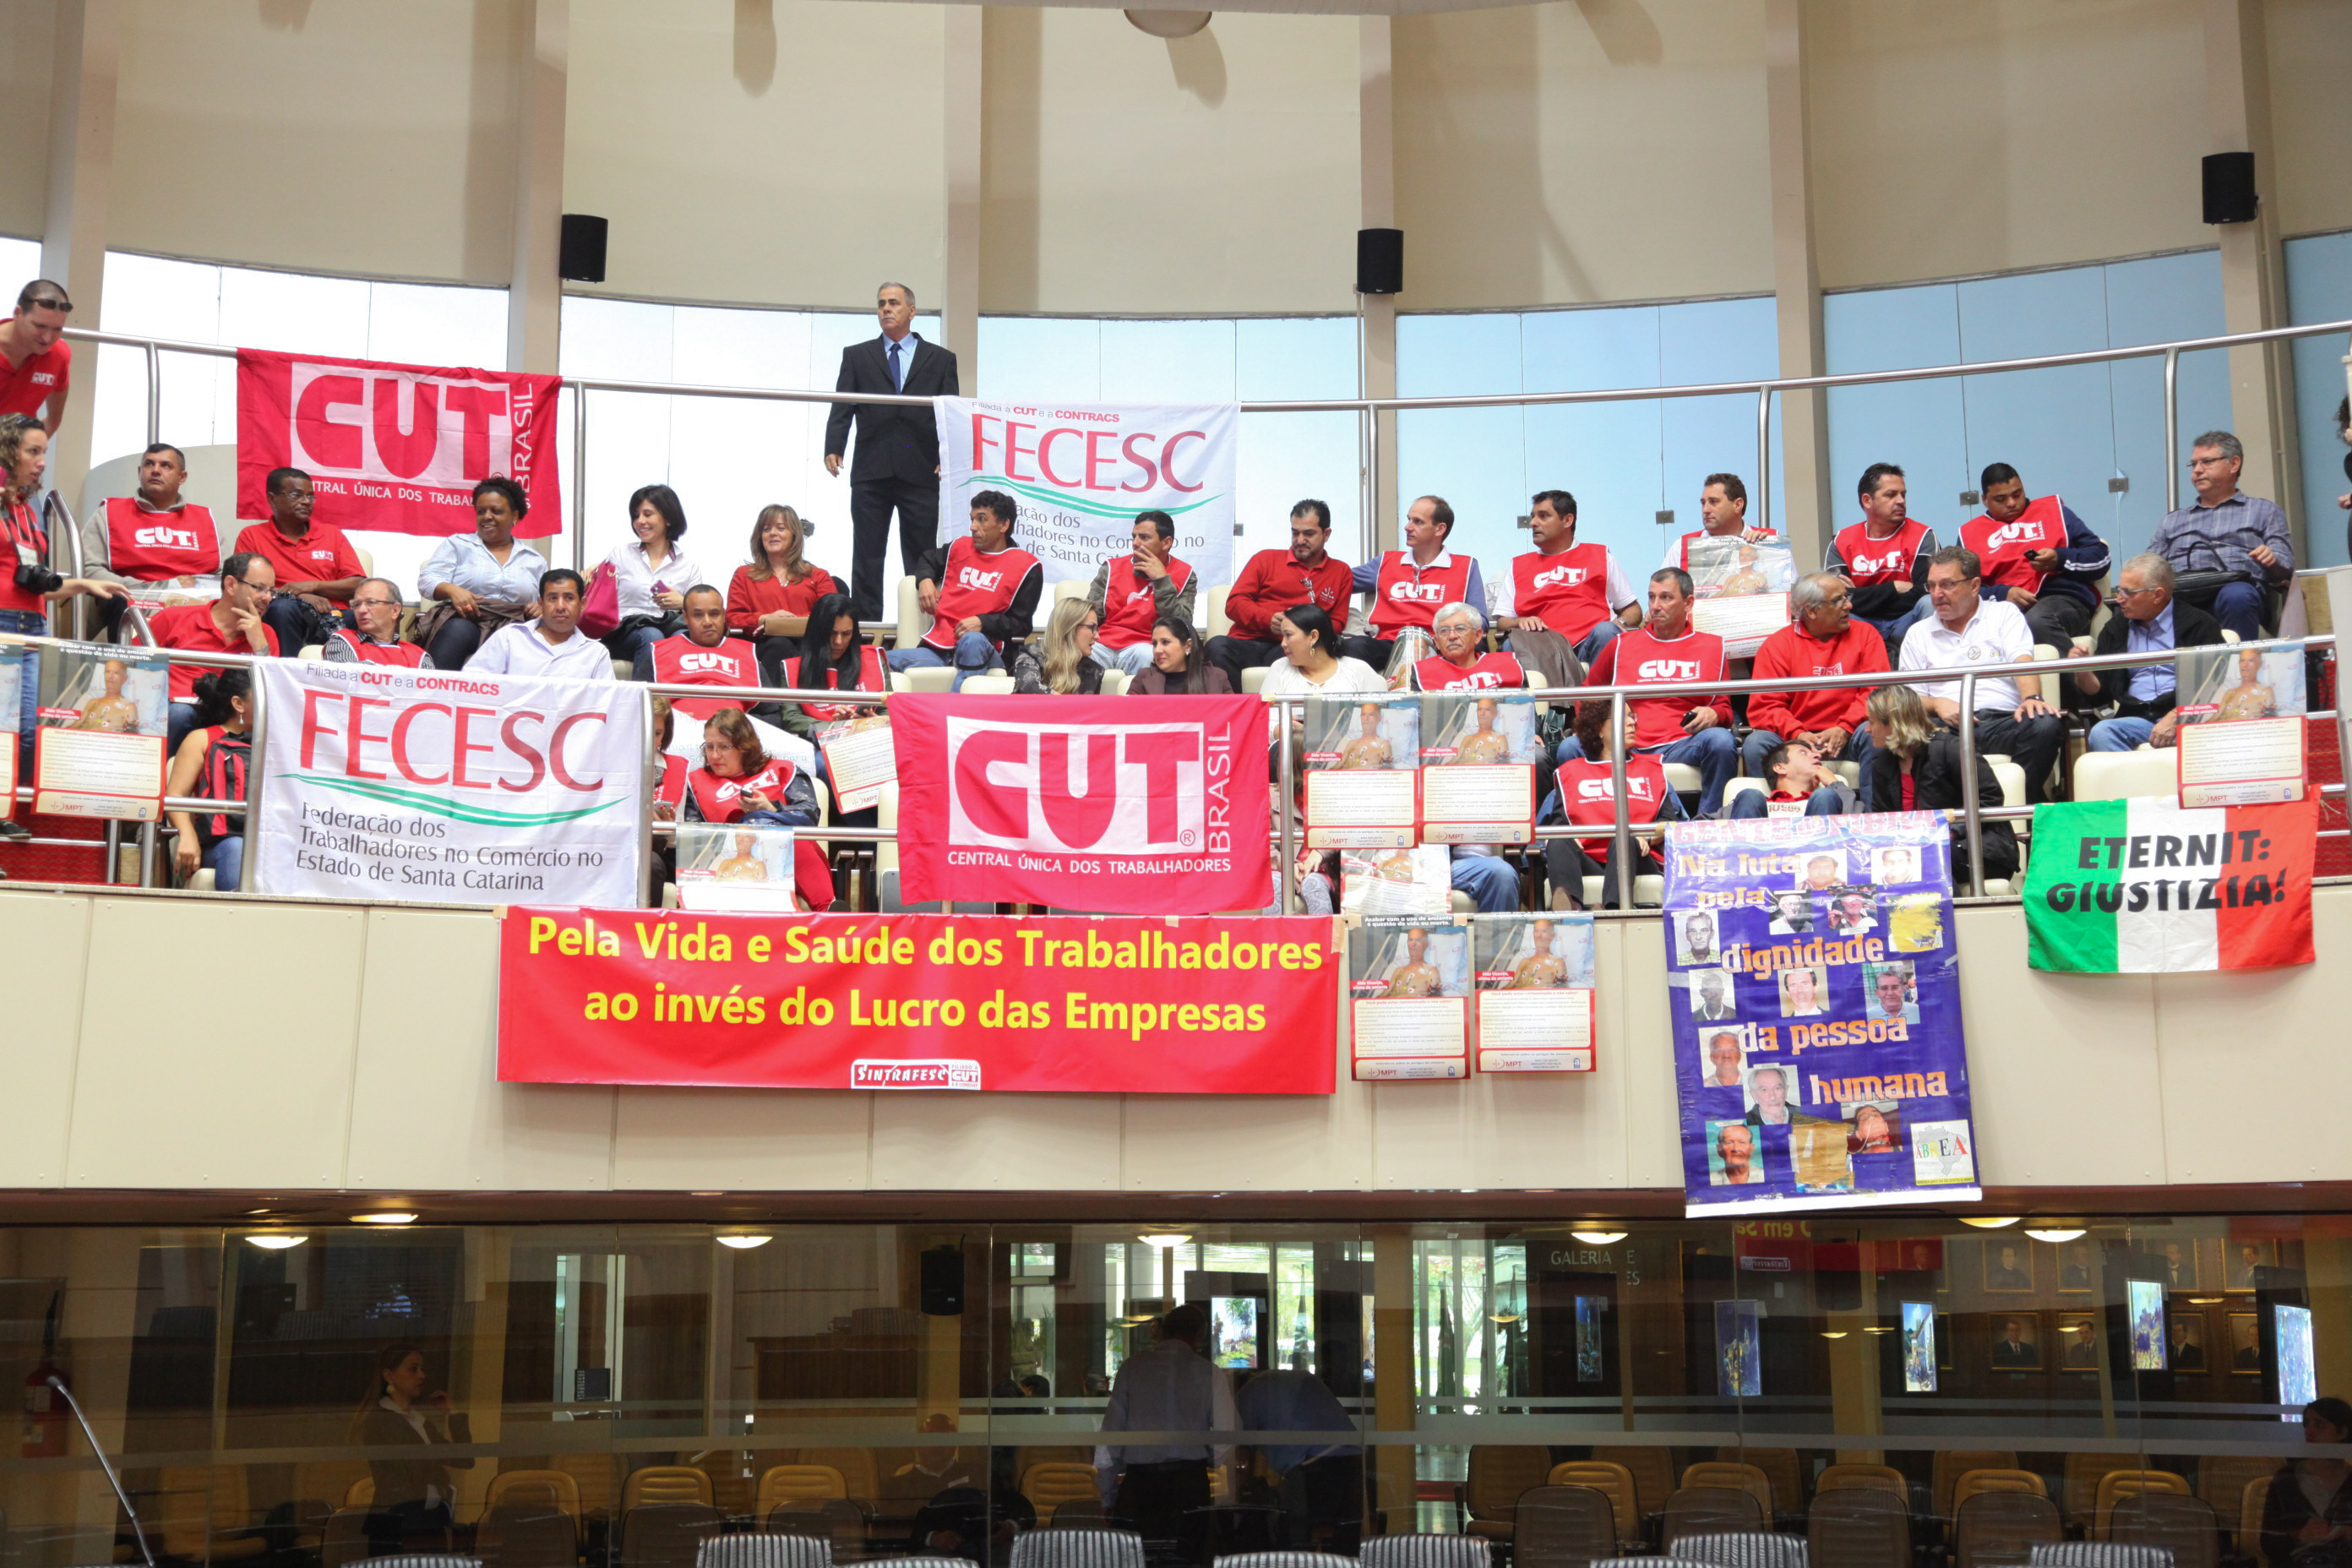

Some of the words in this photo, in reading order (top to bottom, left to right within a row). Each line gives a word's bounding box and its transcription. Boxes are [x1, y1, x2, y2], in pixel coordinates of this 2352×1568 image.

[972, 401, 1002, 412] Filiada
[1013, 406, 1037, 416] CUT
[1055, 410, 1120, 422] CONTRACS
[296, 374, 507, 480] CUT
[514, 383, 533, 493] BRASIL
[972, 413, 1206, 493] FECESC
[354, 481, 392, 498] ÚNICA
[399, 488, 423, 502] DOS
[1053, 511, 1081, 529] dos
[135, 526, 191, 546] CUT
[1081, 536, 1100, 548] no
[1185, 535, 1205, 547] no
[1987, 522, 2037, 548] CUT
[1026, 540, 1045, 555] de
[1050, 544, 1091, 565] Santa
[1853, 551, 1901, 573] CUT
[960, 566, 999, 587] CUT
[1533, 565, 1582, 588] CUT
[1391, 581, 1441, 599] CUT
[679, 653, 734, 673] CUT
[1638, 660, 1696, 678] CUT
[307, 663, 347, 682] Filiada
[350, 672, 359, 682] a
[361, 672, 393, 686] CUT
[394, 678, 403, 688] e
[406, 678, 414, 689] a
[416, 677, 500, 696] CONTRACS
[300, 689, 607, 792] FECESC
[863, 794, 878, 804] MPT
[955, 729, 1200, 849] CUT
[1208, 722, 1231, 852] BRASIL
[302, 802, 402, 839] Federação
[410, 817, 446, 838] dos
[299, 825, 438, 863] Trabalhadores
[444, 847, 469, 864] no
[476, 846, 571, 868] Comércio
[578, 850, 603, 868] no
[2077, 830, 2271, 869] ETERNIT:
[296, 850, 362, 878] Estado
[368, 860, 395, 882] de
[400, 864, 456, 888] Santa
[462, 868, 545, 890] Catarina
[948, 851, 1012, 868] CENTRAL
[1018, 853, 1062, 874] ÚNICA
[1070, 860, 1100, 874] DOS
[1108, 858, 1231, 874] TRABALHADORES
[1678, 854, 1728, 878] Na
[1738, 852, 1801, 876] luta
[1696, 886, 1766, 911] pela
[2046, 868, 2286, 913] GIUSTIZIA!
[530, 917, 621, 957] Pela
[634, 922, 732, 962] Vida
[747, 934, 770, 962] e
[786, 924, 915, 965] Saúde
[928, 926, 1003, 966] dos
[1016, 929, 1322, 970] Trabalhadores
[1721, 933, 1885, 979] dignidade
[584, 991, 639, 1021] ao
[654, 982, 765, 1025] invés
[779, 986, 834, 1026] do
[850, 988, 966, 1027] Lucro
[978, 988, 1050, 1028] das
[1066, 992, 1266, 1041] Empresas
[1739, 1021, 1779, 1053] da
[1790, 1016, 1908, 1054] pessoa
[951, 1070, 978, 1081] CUT
[1809, 1070, 1948, 1105] humana
[1915, 1135, 1968, 1158] ABREA
[1551, 1250, 1612, 1266] GALERIA
